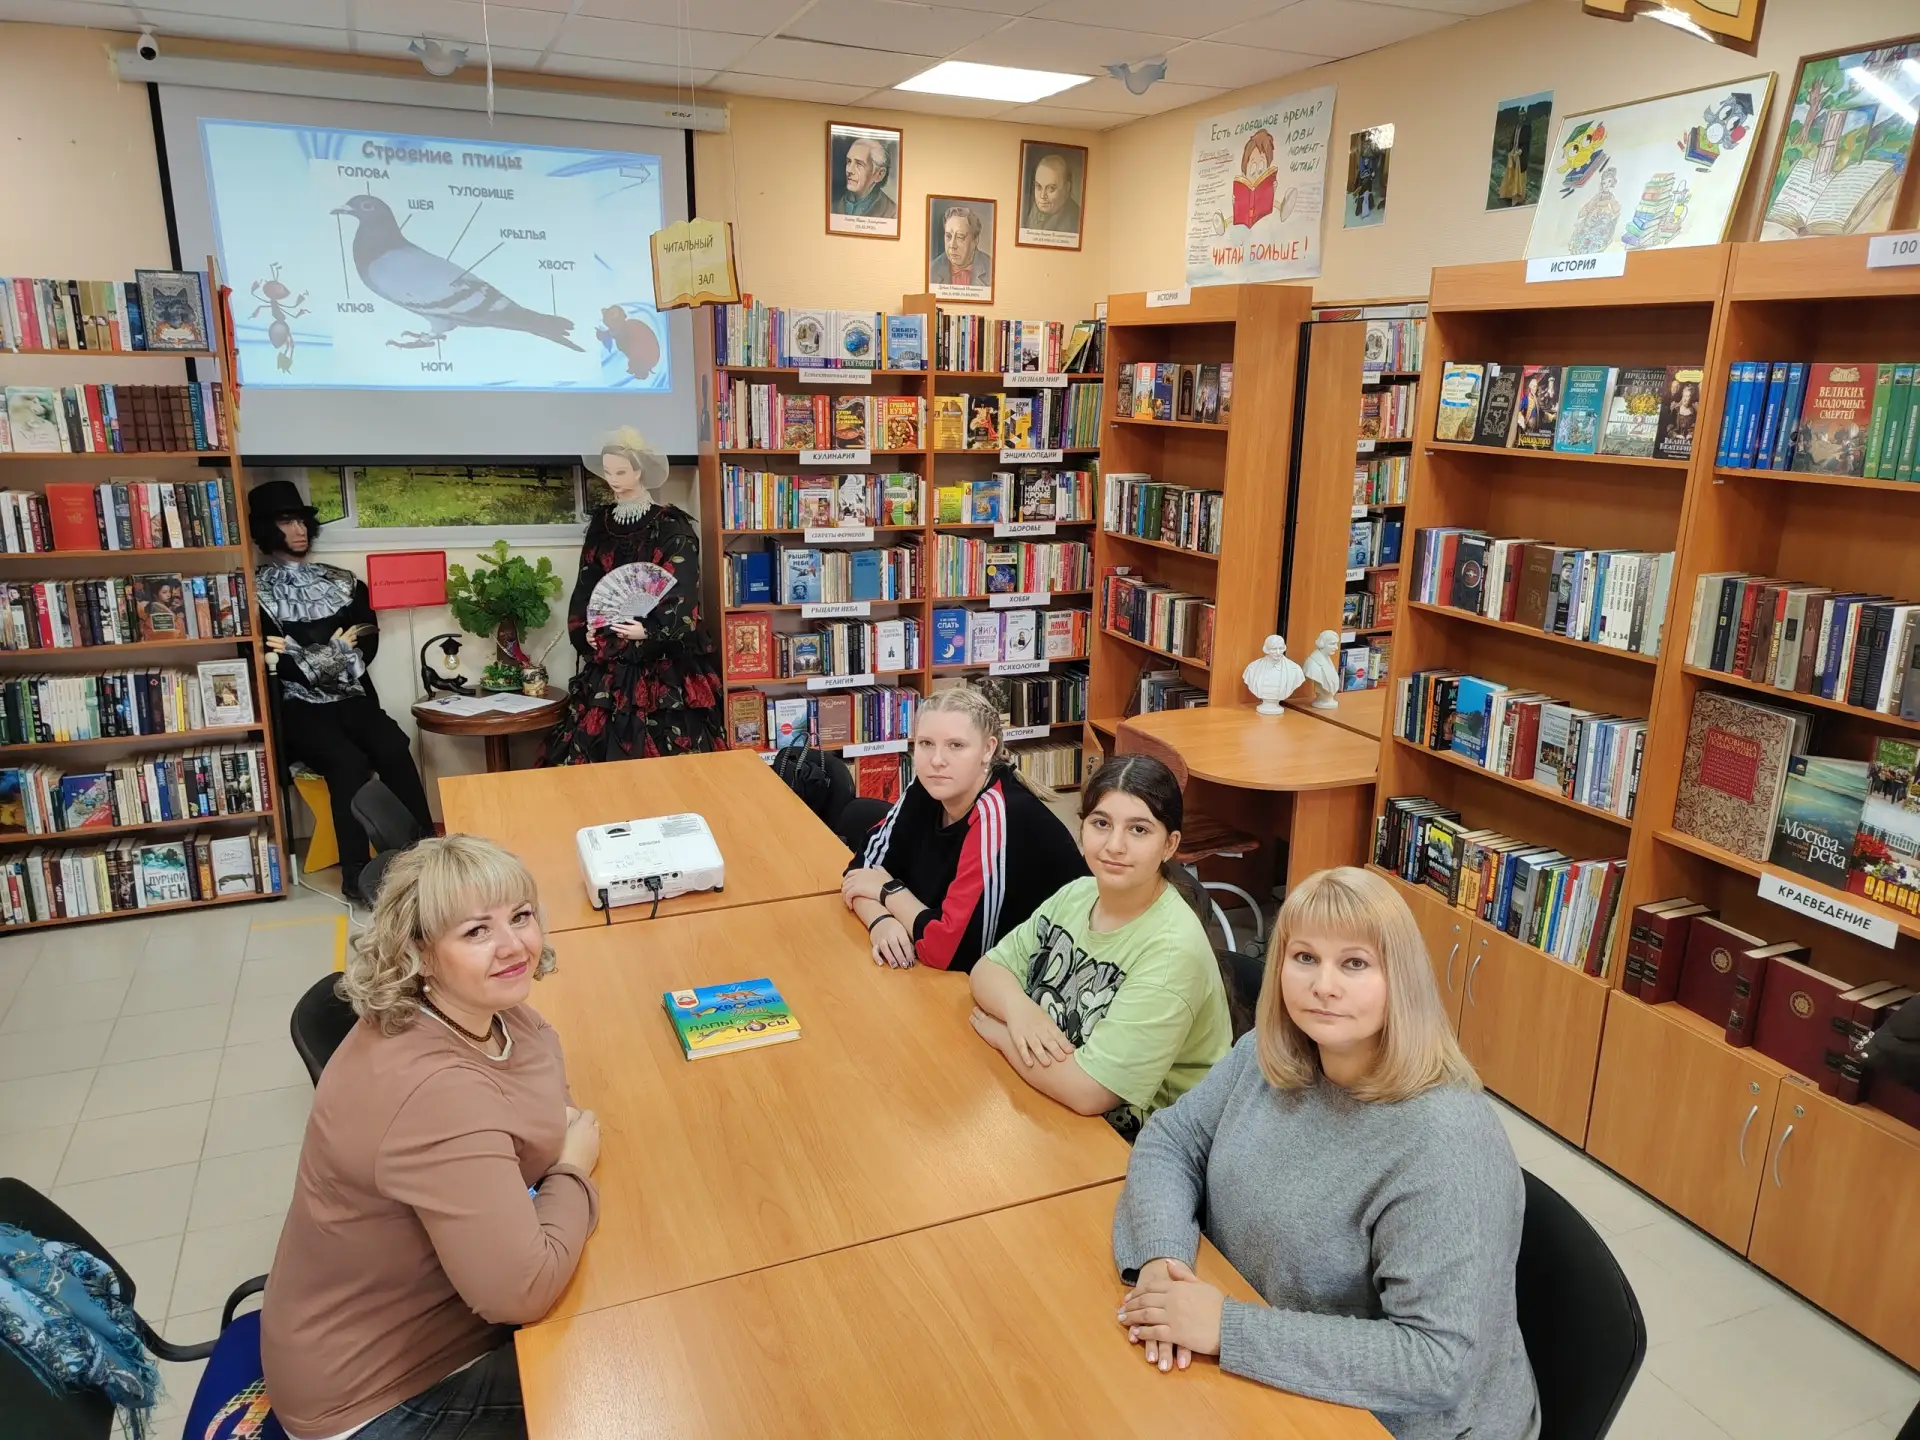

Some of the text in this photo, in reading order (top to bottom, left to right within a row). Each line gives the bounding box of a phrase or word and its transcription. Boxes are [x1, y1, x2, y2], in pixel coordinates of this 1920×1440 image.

[362, 140, 523, 171] Строение птицы
[337, 165, 390, 180] ГОЛОВА
[448, 185, 515, 200] ТУЛОВИЩЕ
[407, 199, 434, 211] ШЕЯ
[500, 228, 546, 240] КРЫЛЬЯ
[663, 235, 714, 254] ЧИТАЛЬНЫЙ
[1892, 240, 1918, 255] 100
[1212, 242, 1244, 266] ЧИТАЙ
[538, 259, 575, 271] ХВОСТ
[1550, 258, 1596, 273] ИСТОРИЯ
[698, 273, 714, 286] ЗАЛ
[337, 302, 375, 313] КЛЮВ
[421, 362, 453, 372] НОГИ
[1819, 387, 1865, 398] ВЕЛИКИХ
[1813, 399, 1865, 409] ЗАГАДОЧНЫХ
[1819, 409, 1855, 420] СМЕРТЕЙ
[1664, 437, 1692, 446] ВЕЛИКА
[813, 452, 855, 460] КУЛИНАРИЯ
[1004, 451, 1057, 459] ЭНЦИКЛОПЕДИИ
[1008, 524, 1042, 533] ЗДОРОВЬЕ
[811, 605, 858, 614] РЫЦАРИ НЕБА
[1051, 620, 1069, 628] НАУКА
[973, 627, 997, 635] КНИГА
[998, 662, 1041, 671] ПСИХОЛОГИЯ
[825, 677, 854, 686] РЕЛИГИЯ
[1006, 729, 1034, 737] ИСТОРИЯ
[1709, 731, 1757, 752] СОКРОВИЩА
[1807, 844, 1847, 869] река
[149, 871, 187, 887] ДУРНОЙ
[160, 883, 188, 900] ГЕН
[1863, 875, 1920, 914] ОДИНЦ
[1778, 885, 1872, 930] КРАЕВЕДЕНИЕ
[689, 1020, 733, 1032] ЛАПЫ
[737, 1019, 790, 1034] НОСЫ
